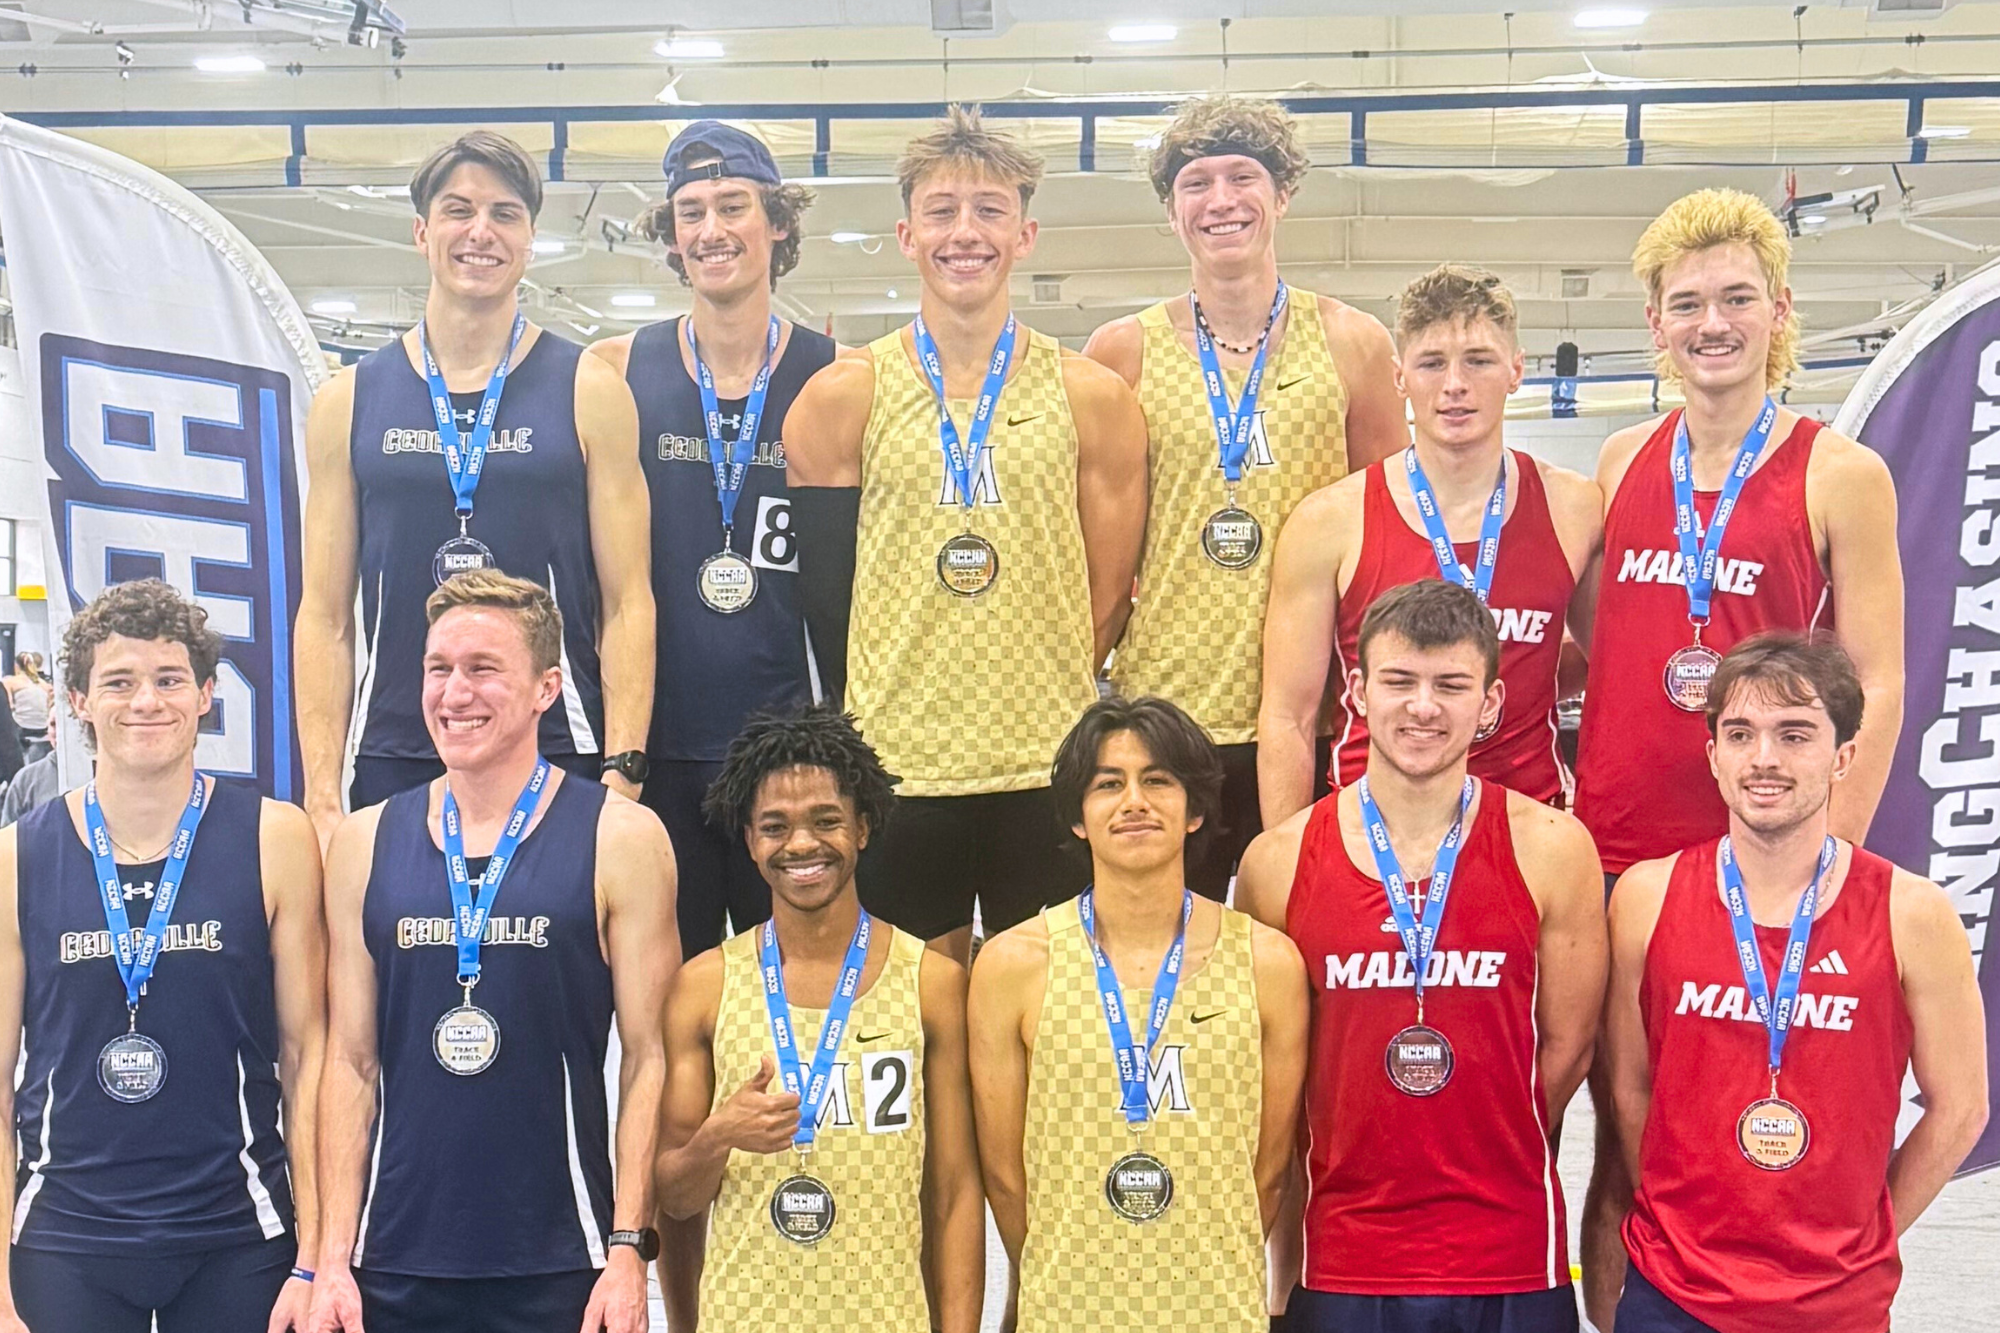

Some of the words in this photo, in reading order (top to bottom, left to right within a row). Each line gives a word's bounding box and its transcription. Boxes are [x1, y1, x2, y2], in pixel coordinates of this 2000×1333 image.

[760, 504, 796, 566] 8
[444, 554, 483, 569] NCCAA
[1325, 951, 1507, 989] MALONE
[447, 1025, 486, 1041] NCCAA
[110, 1052, 153, 1069] NCCAA
[1399, 1045, 1441, 1060] NCCAA
[1119, 1045, 1190, 1112] M
[870, 1057, 907, 1127] 2
[1752, 1118, 1795, 1134] NCCAA
[1119, 1170, 1160, 1187] NCCAA
[783, 1193, 823, 1210] NCCAA
